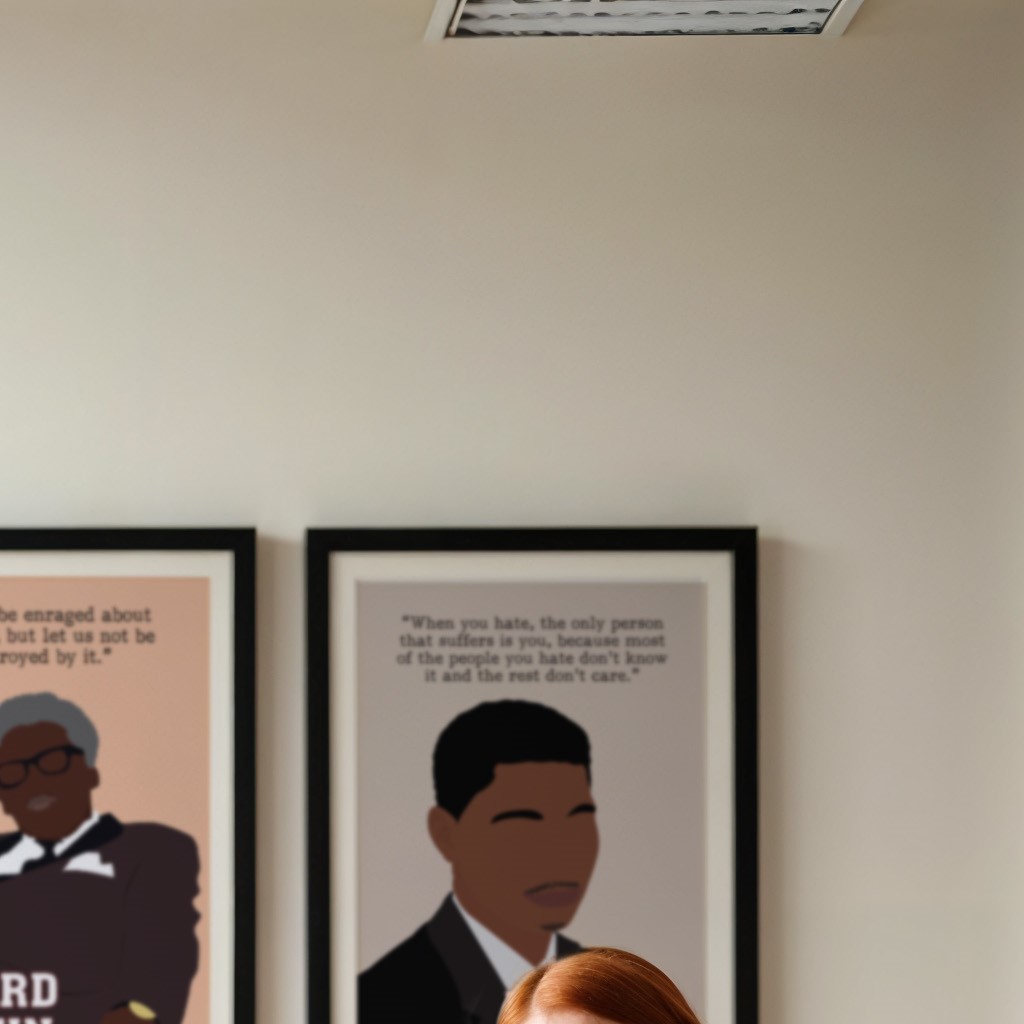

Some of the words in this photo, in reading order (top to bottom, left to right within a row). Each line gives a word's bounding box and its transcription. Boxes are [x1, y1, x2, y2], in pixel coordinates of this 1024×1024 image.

[23, 606, 94, 627] enraged
[101, 606, 152, 622] about
[460, 619, 488, 634] you
[494, 615, 535, 632] hate,
[540, 615, 566, 631] the
[571, 615, 605, 634] only
[611, 619, 664, 634] person
[6, 627, 36, 644] but
[42, 627, 66, 644] let
[73, 630, 93, 644] us
[100, 629, 129, 644] not
[135, 627, 155, 644] be
[399, 633, 433, 648] that
[439, 633, 494, 648] suffers
[500, 633, 513, 648] is
[519, 637, 552, 651] you,
[558, 633, 619, 648] because
[625, 635, 666, 648] most
[56, 648, 76, 668] by
[396, 651, 412, 665] of
[418, 651, 443, 665] the
[449, 651, 500, 668] people
[505, 654, 536, 668] you
[539, 651, 575, 665] hate
[579, 651, 620, 665] don't
[625, 651, 667, 665] know
[424, 668, 436, 682] it
[442, 668, 472, 682] and
[477, 668, 503, 682] the
[509, 670, 539, 682] rest
[545, 668, 586, 682] don't
